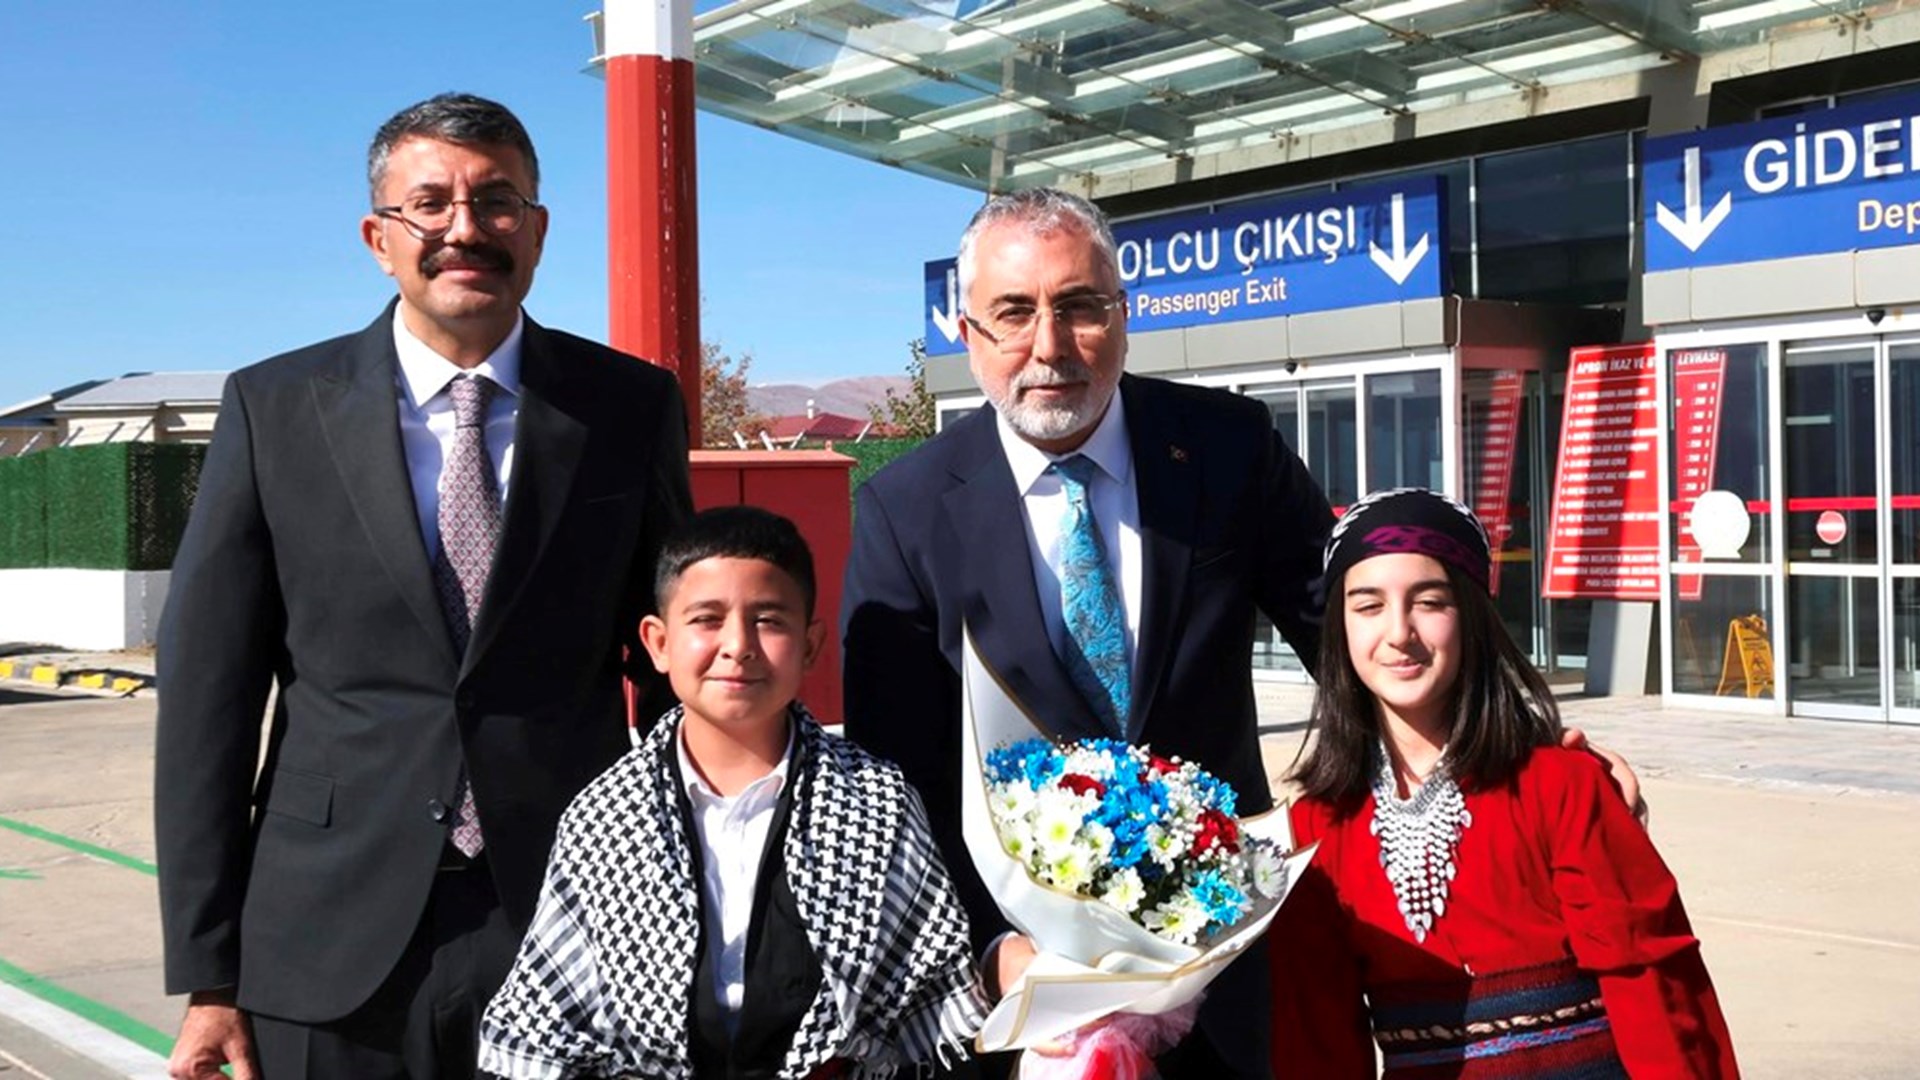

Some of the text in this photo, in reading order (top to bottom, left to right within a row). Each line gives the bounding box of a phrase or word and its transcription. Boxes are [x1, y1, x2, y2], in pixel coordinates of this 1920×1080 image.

[1116, 205, 1356, 281] OLCU ÇIKIŞI
[1136, 286, 1241, 318] Passenger
[1245, 276, 1287, 305] Exit
